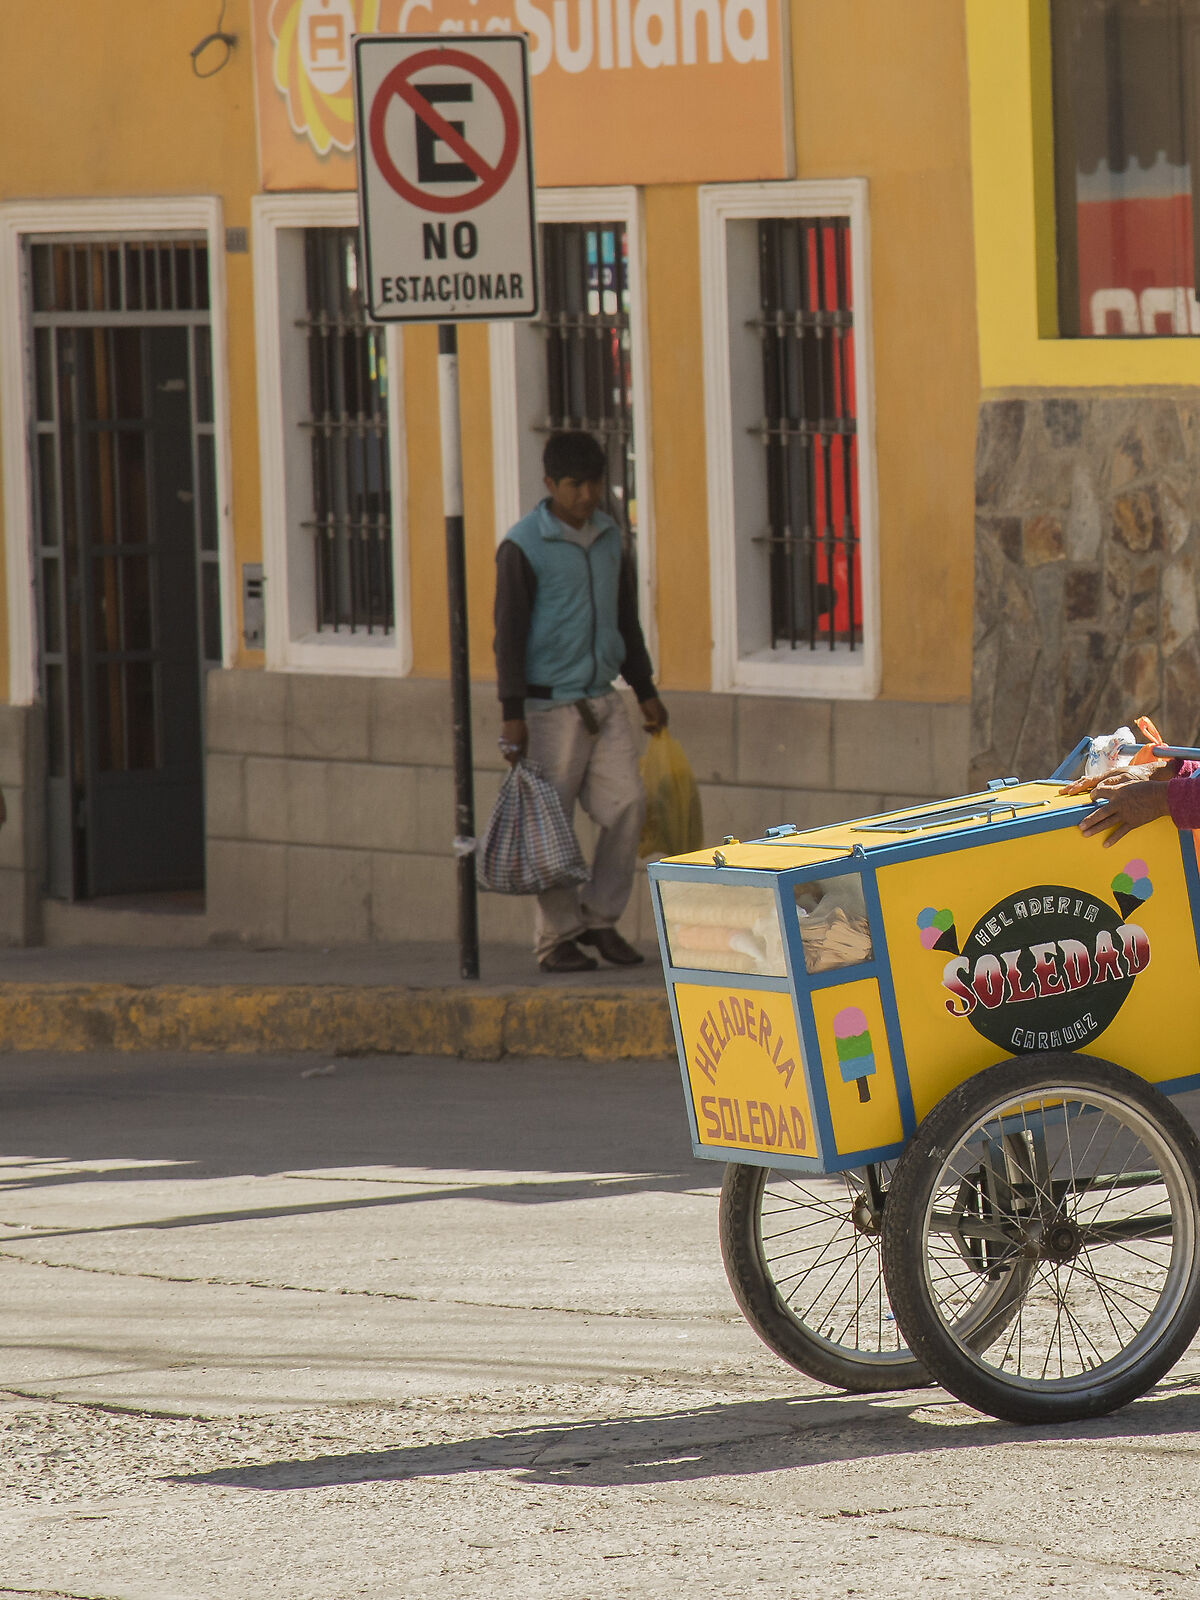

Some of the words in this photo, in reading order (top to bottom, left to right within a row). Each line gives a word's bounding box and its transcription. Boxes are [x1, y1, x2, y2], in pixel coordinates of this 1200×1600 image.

[423, 221, 478, 260] NO
[381, 273, 523, 303] ESTACIONAR
[974, 896, 1100, 947] HELADERIA
[941, 923, 1151, 1018] SOLEDAD
[695, 996, 796, 1089] HELADERIA
[1011, 1012, 1098, 1049] CARHUAZ
[701, 1095, 806, 1150] SOLEDAD
